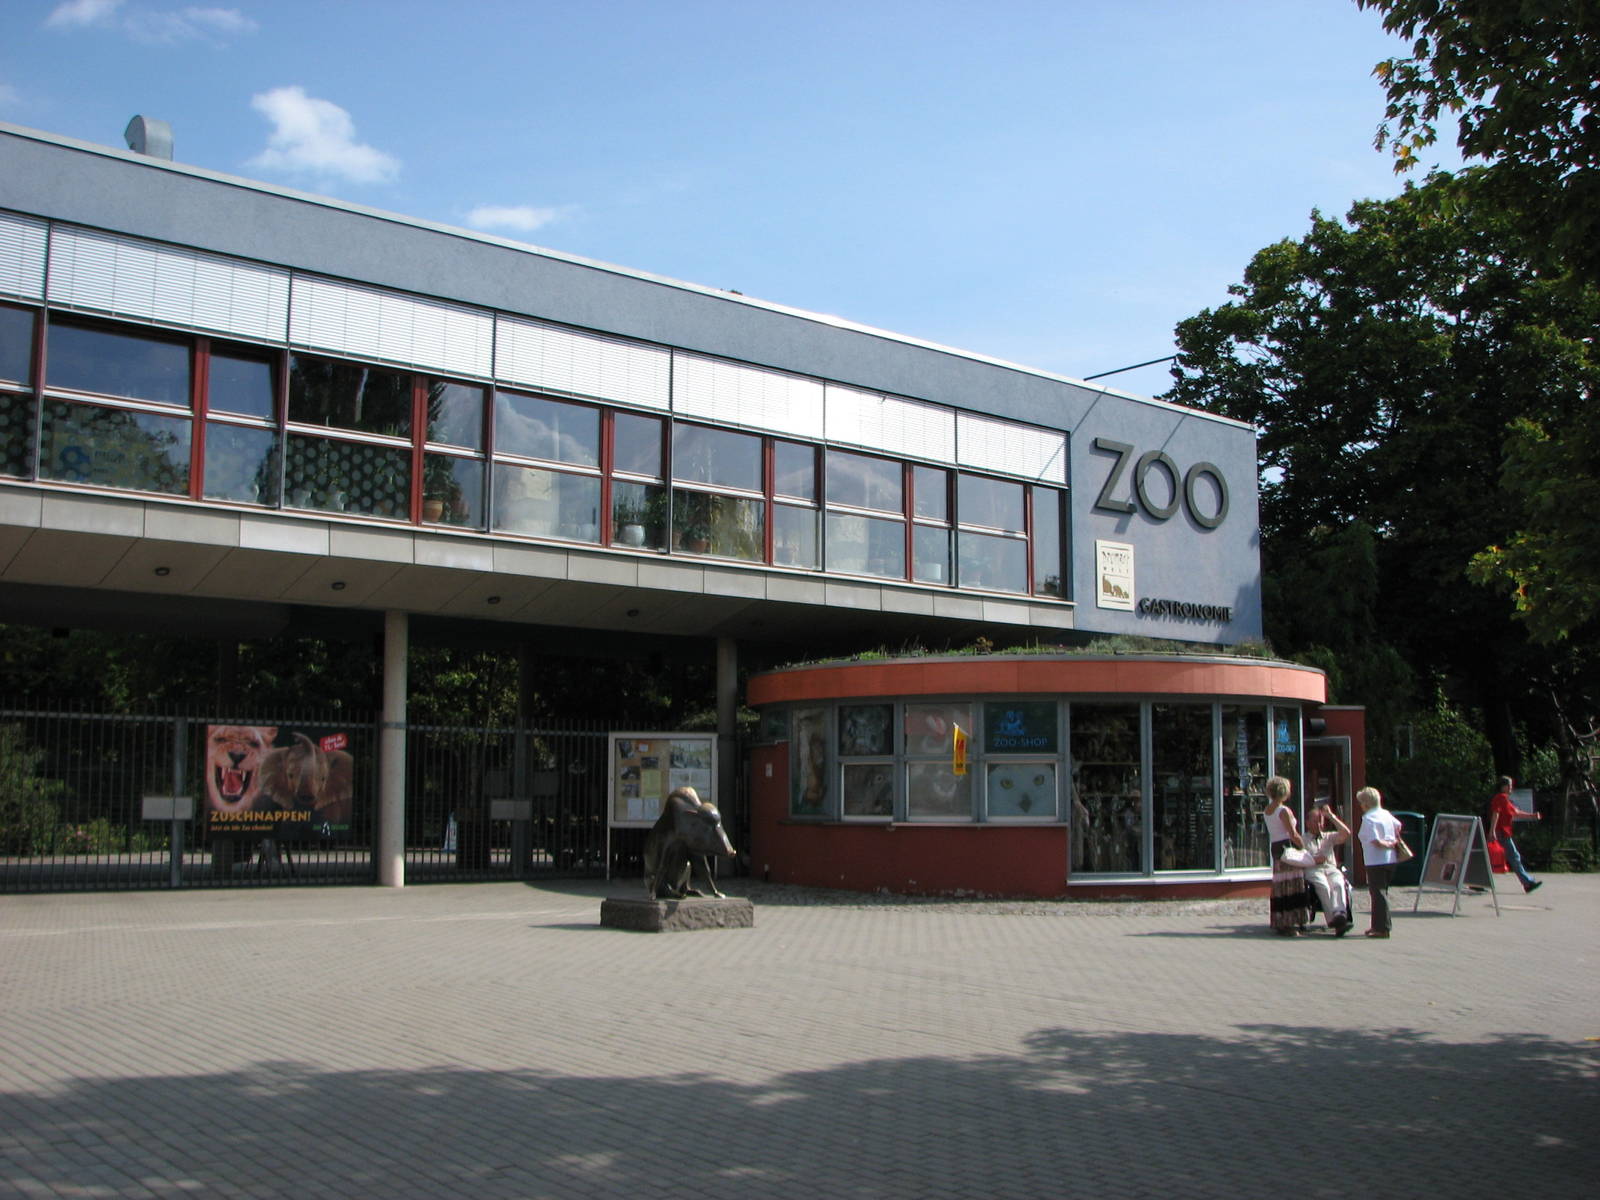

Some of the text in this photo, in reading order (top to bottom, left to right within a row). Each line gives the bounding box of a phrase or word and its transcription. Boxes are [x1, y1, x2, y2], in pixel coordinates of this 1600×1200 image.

[1094, 438, 1230, 529] ZOO
[1139, 598, 1233, 623] GASTRONOMIE
[993, 737, 1048, 748] ZOO-SHOP
[210, 810, 312, 823] ZUSCHNAPPEN!
